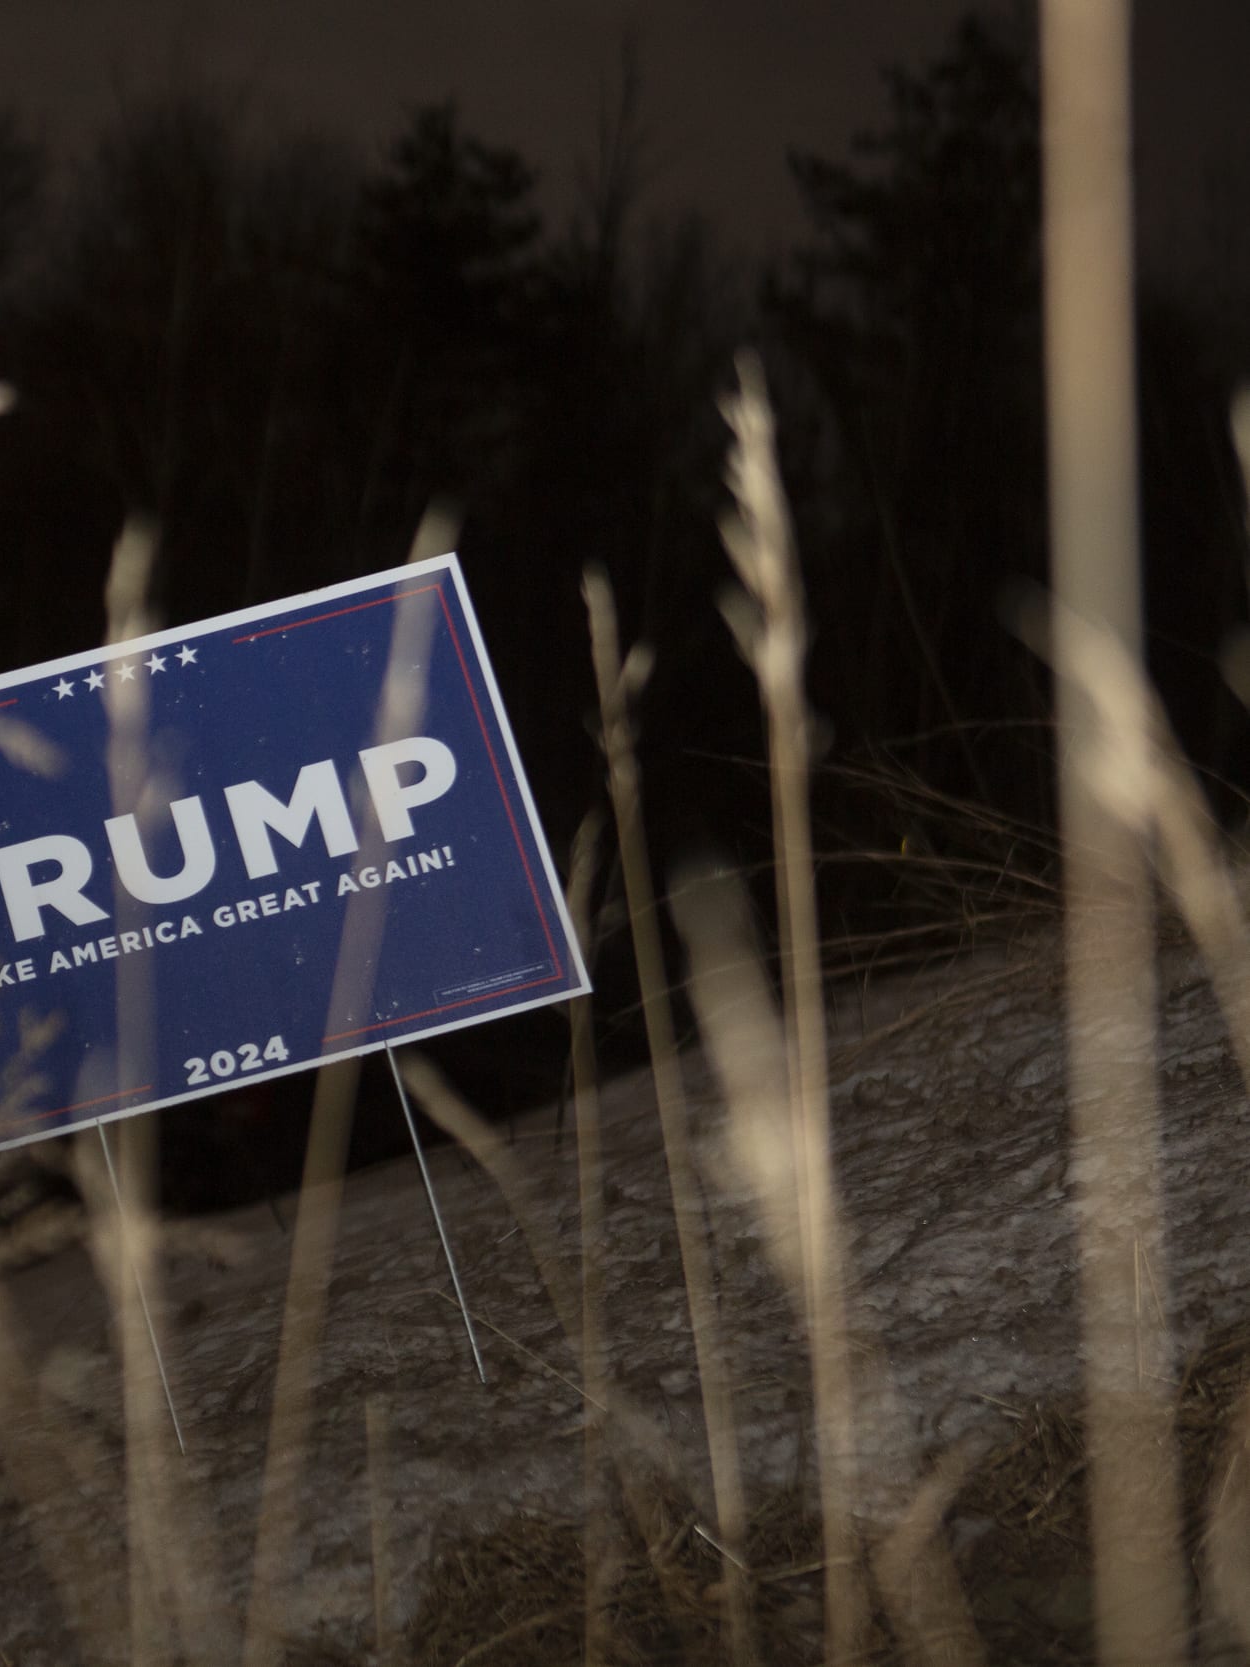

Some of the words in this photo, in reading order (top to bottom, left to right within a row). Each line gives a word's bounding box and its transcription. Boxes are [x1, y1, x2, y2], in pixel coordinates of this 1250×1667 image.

[49, 915, 203, 974] AMERICA
[212, 881, 321, 928] GREAT
[337, 845, 455, 897] AGAIN!
[183, 1035, 289, 1086] 2024
